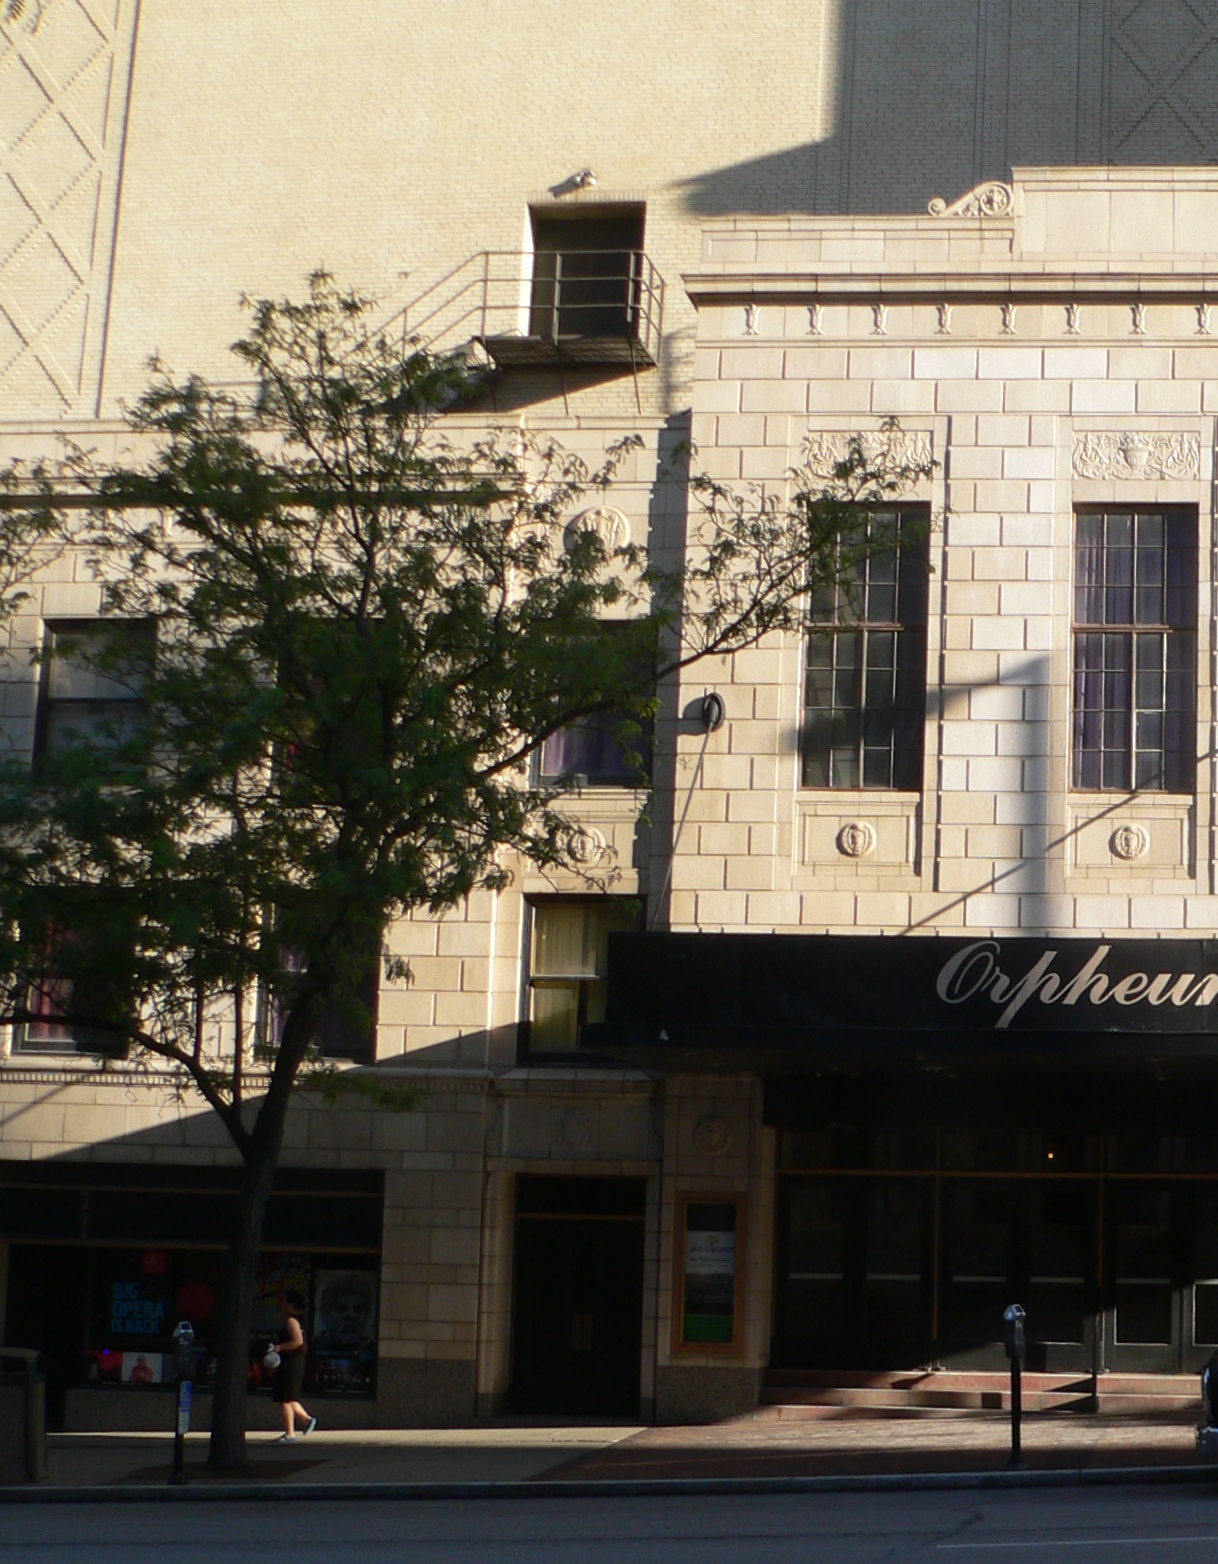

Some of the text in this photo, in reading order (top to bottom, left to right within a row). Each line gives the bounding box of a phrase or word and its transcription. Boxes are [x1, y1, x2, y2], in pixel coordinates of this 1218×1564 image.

[113, 1281, 140, 1300] BIG
[112, 1301, 166, 1318] OPERA
[112, 1318, 161, 1334] IS BACK
